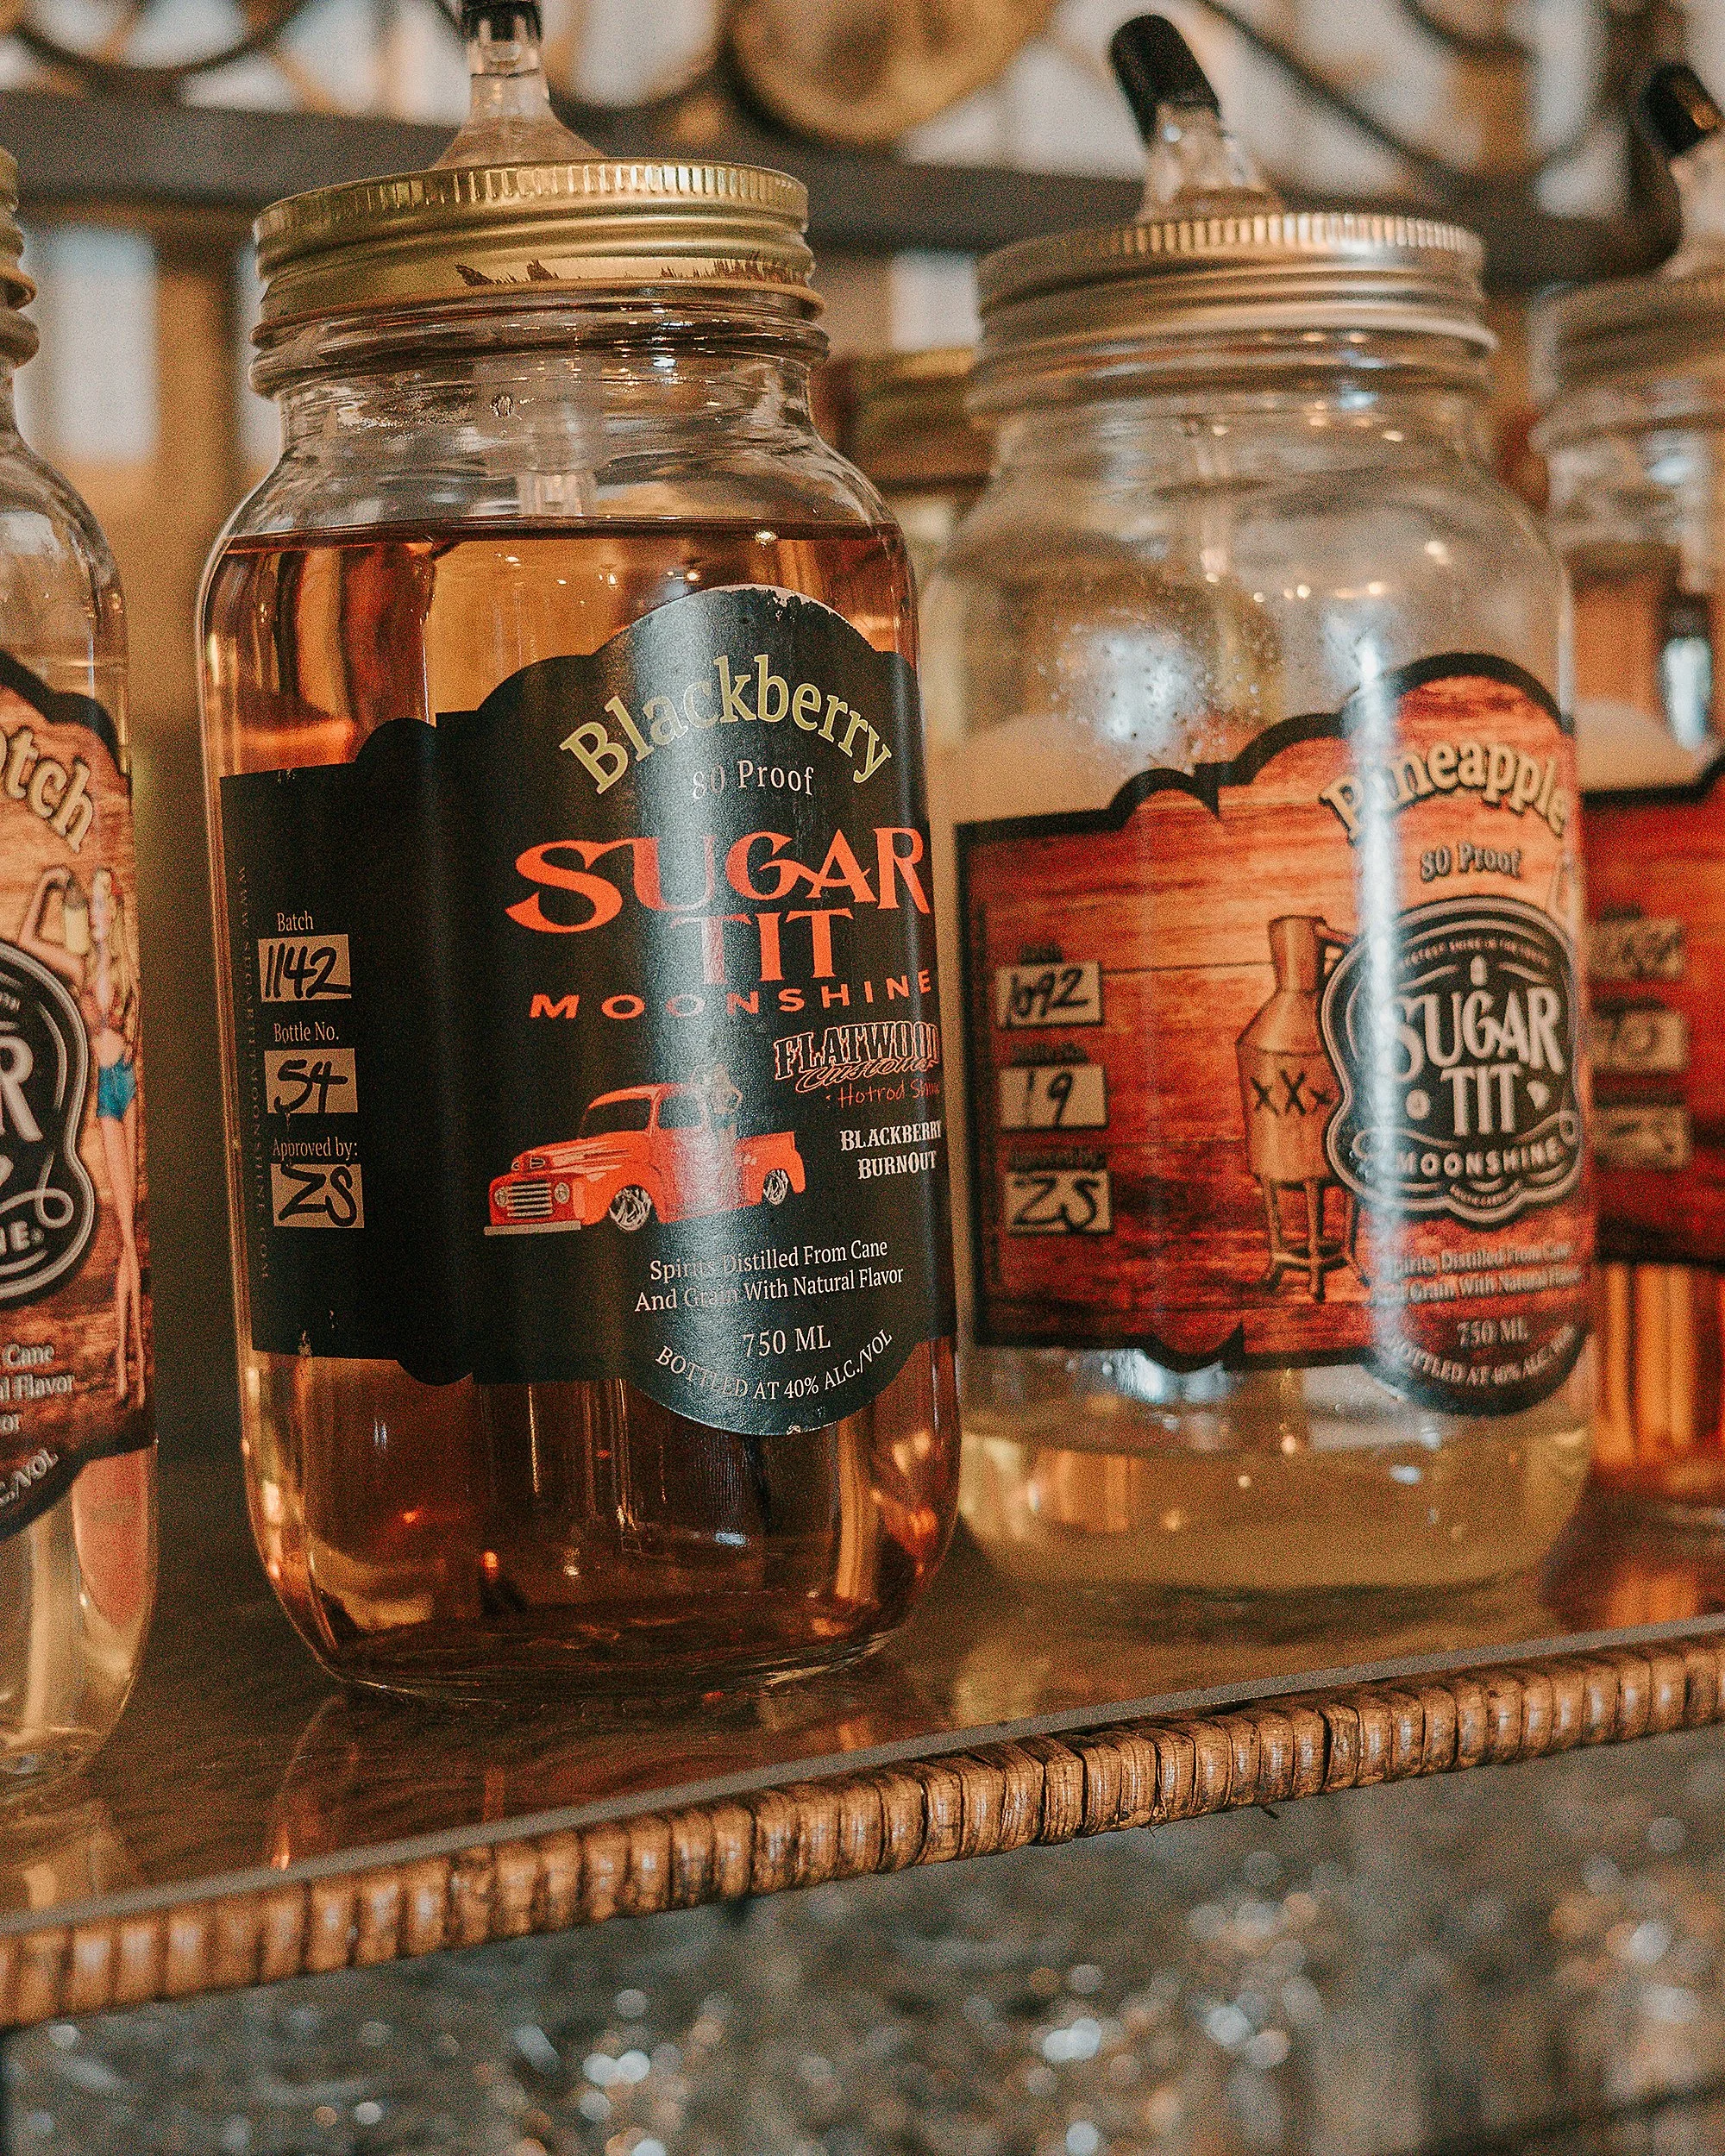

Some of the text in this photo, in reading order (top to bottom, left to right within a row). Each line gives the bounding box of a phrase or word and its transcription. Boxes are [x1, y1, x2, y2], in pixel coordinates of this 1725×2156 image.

[559, 654, 893, 794] Blackberry
[693, 760, 815, 800] 80 Proof
[505, 826, 932, 934] SUGAR
[1458, 843, 1521, 880] Proof
[277, 911, 314, 933] Batch
[671, 907, 854, 985] TIT
[264, 945, 351, 1000] 1142
[530, 968, 932, 1020] MOONSHINE
[274, 1021, 339, 1044] Bottle No.
[1380, 987, 1568, 1084] SUGAR
[274, 1059, 348, 1111] 54
[838, 1080, 905, 1109] Hotrod
[1440, 1064, 1521, 1136] TIT
[273, 1138, 358, 1161] Approved by:
[840, 1120, 942, 1151] BLACKBERRY
[857, 1150, 937, 1180] BURNOUT
[1391, 1135, 1565, 1178] MOONSHINE
[722, 1247, 799, 1273] Distilled
[804, 1244, 847, 1265] From
[850, 1239, 888, 1260] Cane
[635, 1266, 904, 1312] And Grain With Natural Flavor
[743, 1326, 831, 1358] 750 ML
[1457, 1319, 1494, 1348] 750
[3, 1344, 55, 1368] Cane
[656, 1329, 893, 1400] BOTTLED AT 40% ALC./VOL
[14, 1374, 75, 1401] Flavor
